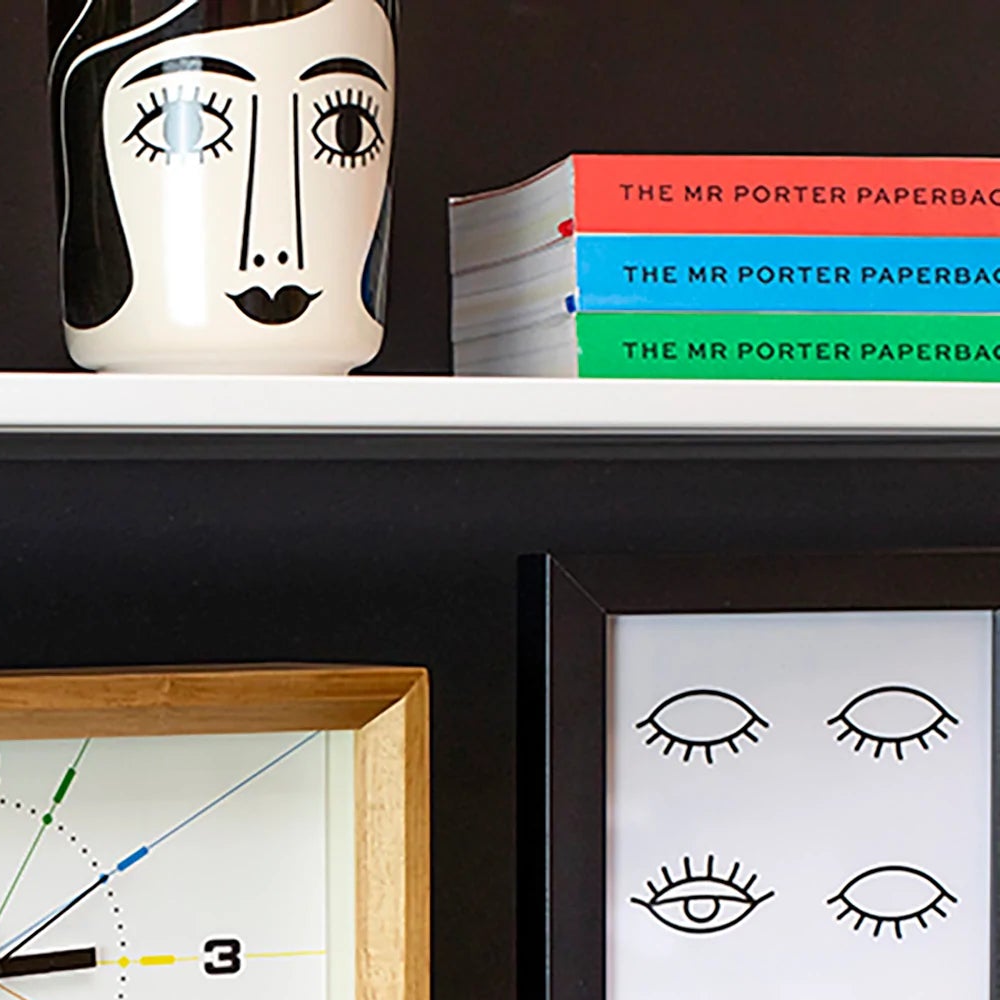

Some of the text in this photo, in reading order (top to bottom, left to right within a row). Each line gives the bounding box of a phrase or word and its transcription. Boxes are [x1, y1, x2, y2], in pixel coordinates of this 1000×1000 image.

[619, 183, 674, 202] THE
[684, 184, 723, 203] MR
[734, 184, 846, 205] PORTER
[622, 265, 678, 284] THE
[688, 265, 727, 284] MR
[738, 265, 851, 285] PORTER
[622, 341, 678, 360] THE
[687, 342, 727, 360] MR
[737, 342, 850, 361] PORTER
[204, 938, 241, 975] 3
